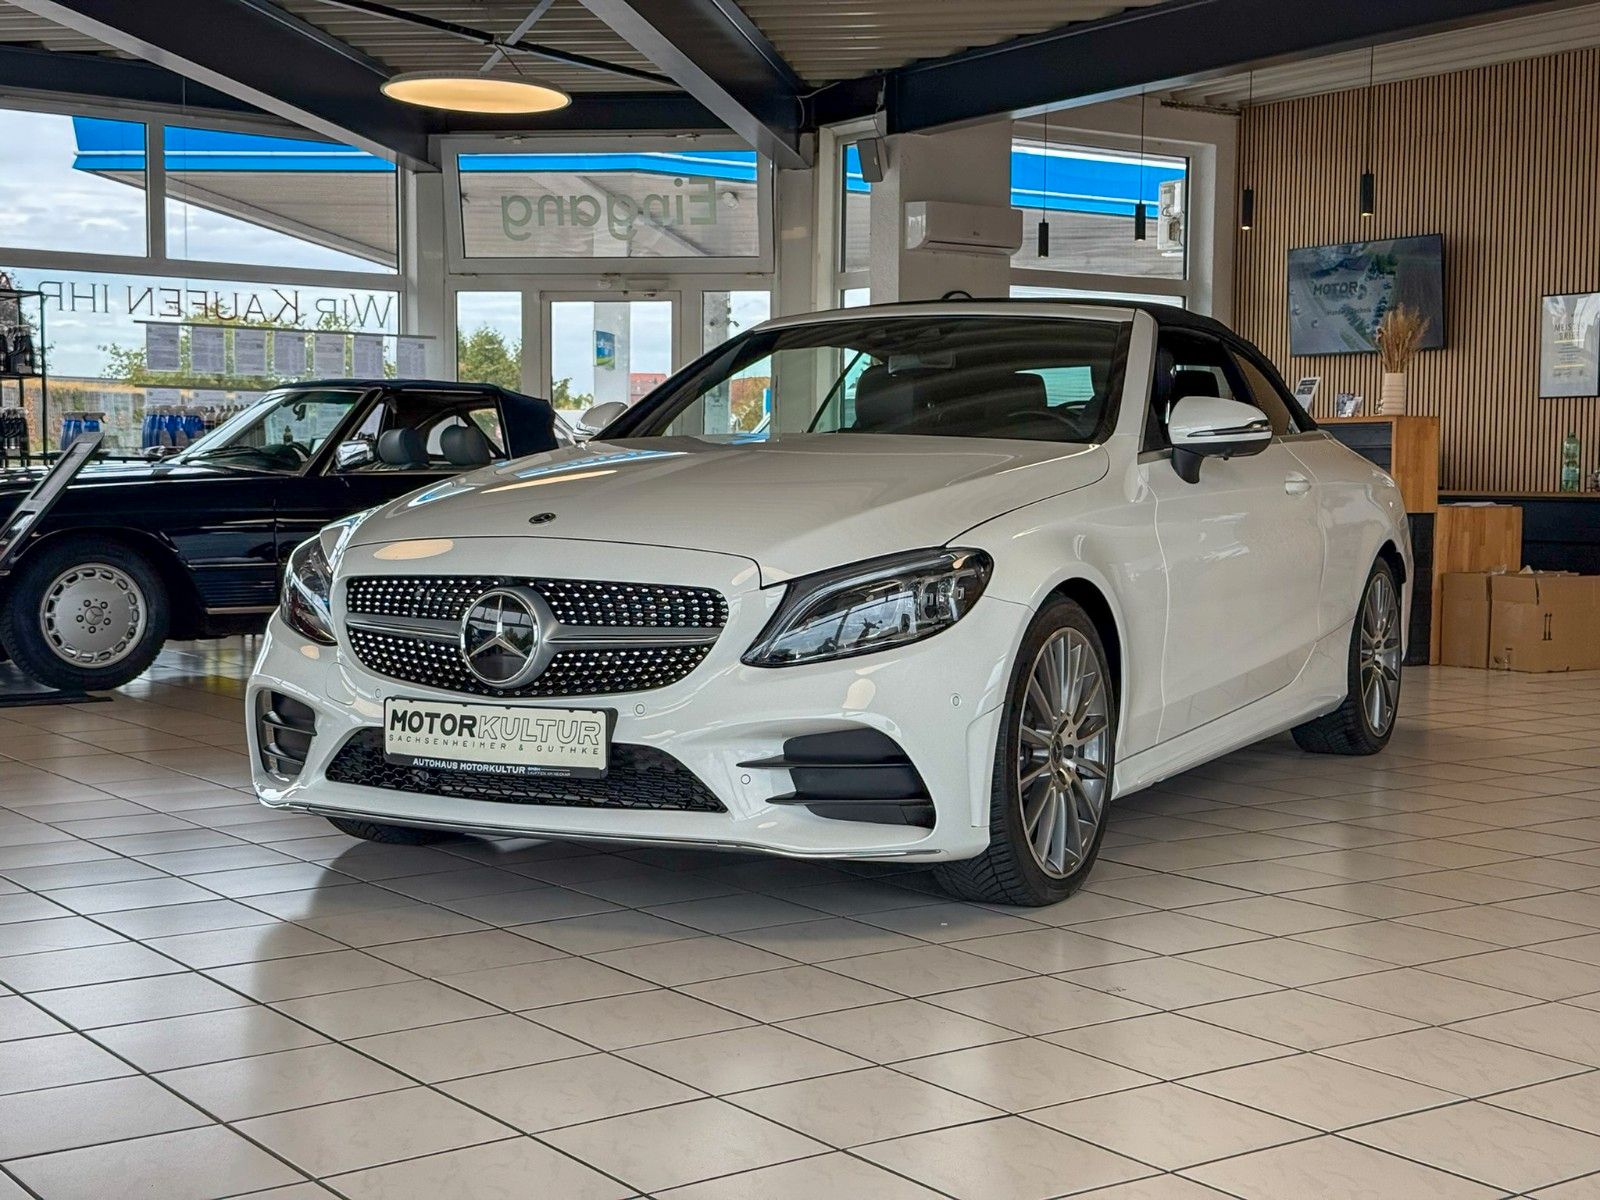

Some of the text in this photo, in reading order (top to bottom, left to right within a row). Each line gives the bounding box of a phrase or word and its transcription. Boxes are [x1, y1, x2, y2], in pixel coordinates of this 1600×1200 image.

[389, 734, 600, 755] SACHSENHEIMER & GUTHKE
[412, 757, 459, 769] AUTOHAUS
[460, 762, 526, 774] MOTORKULTUR
